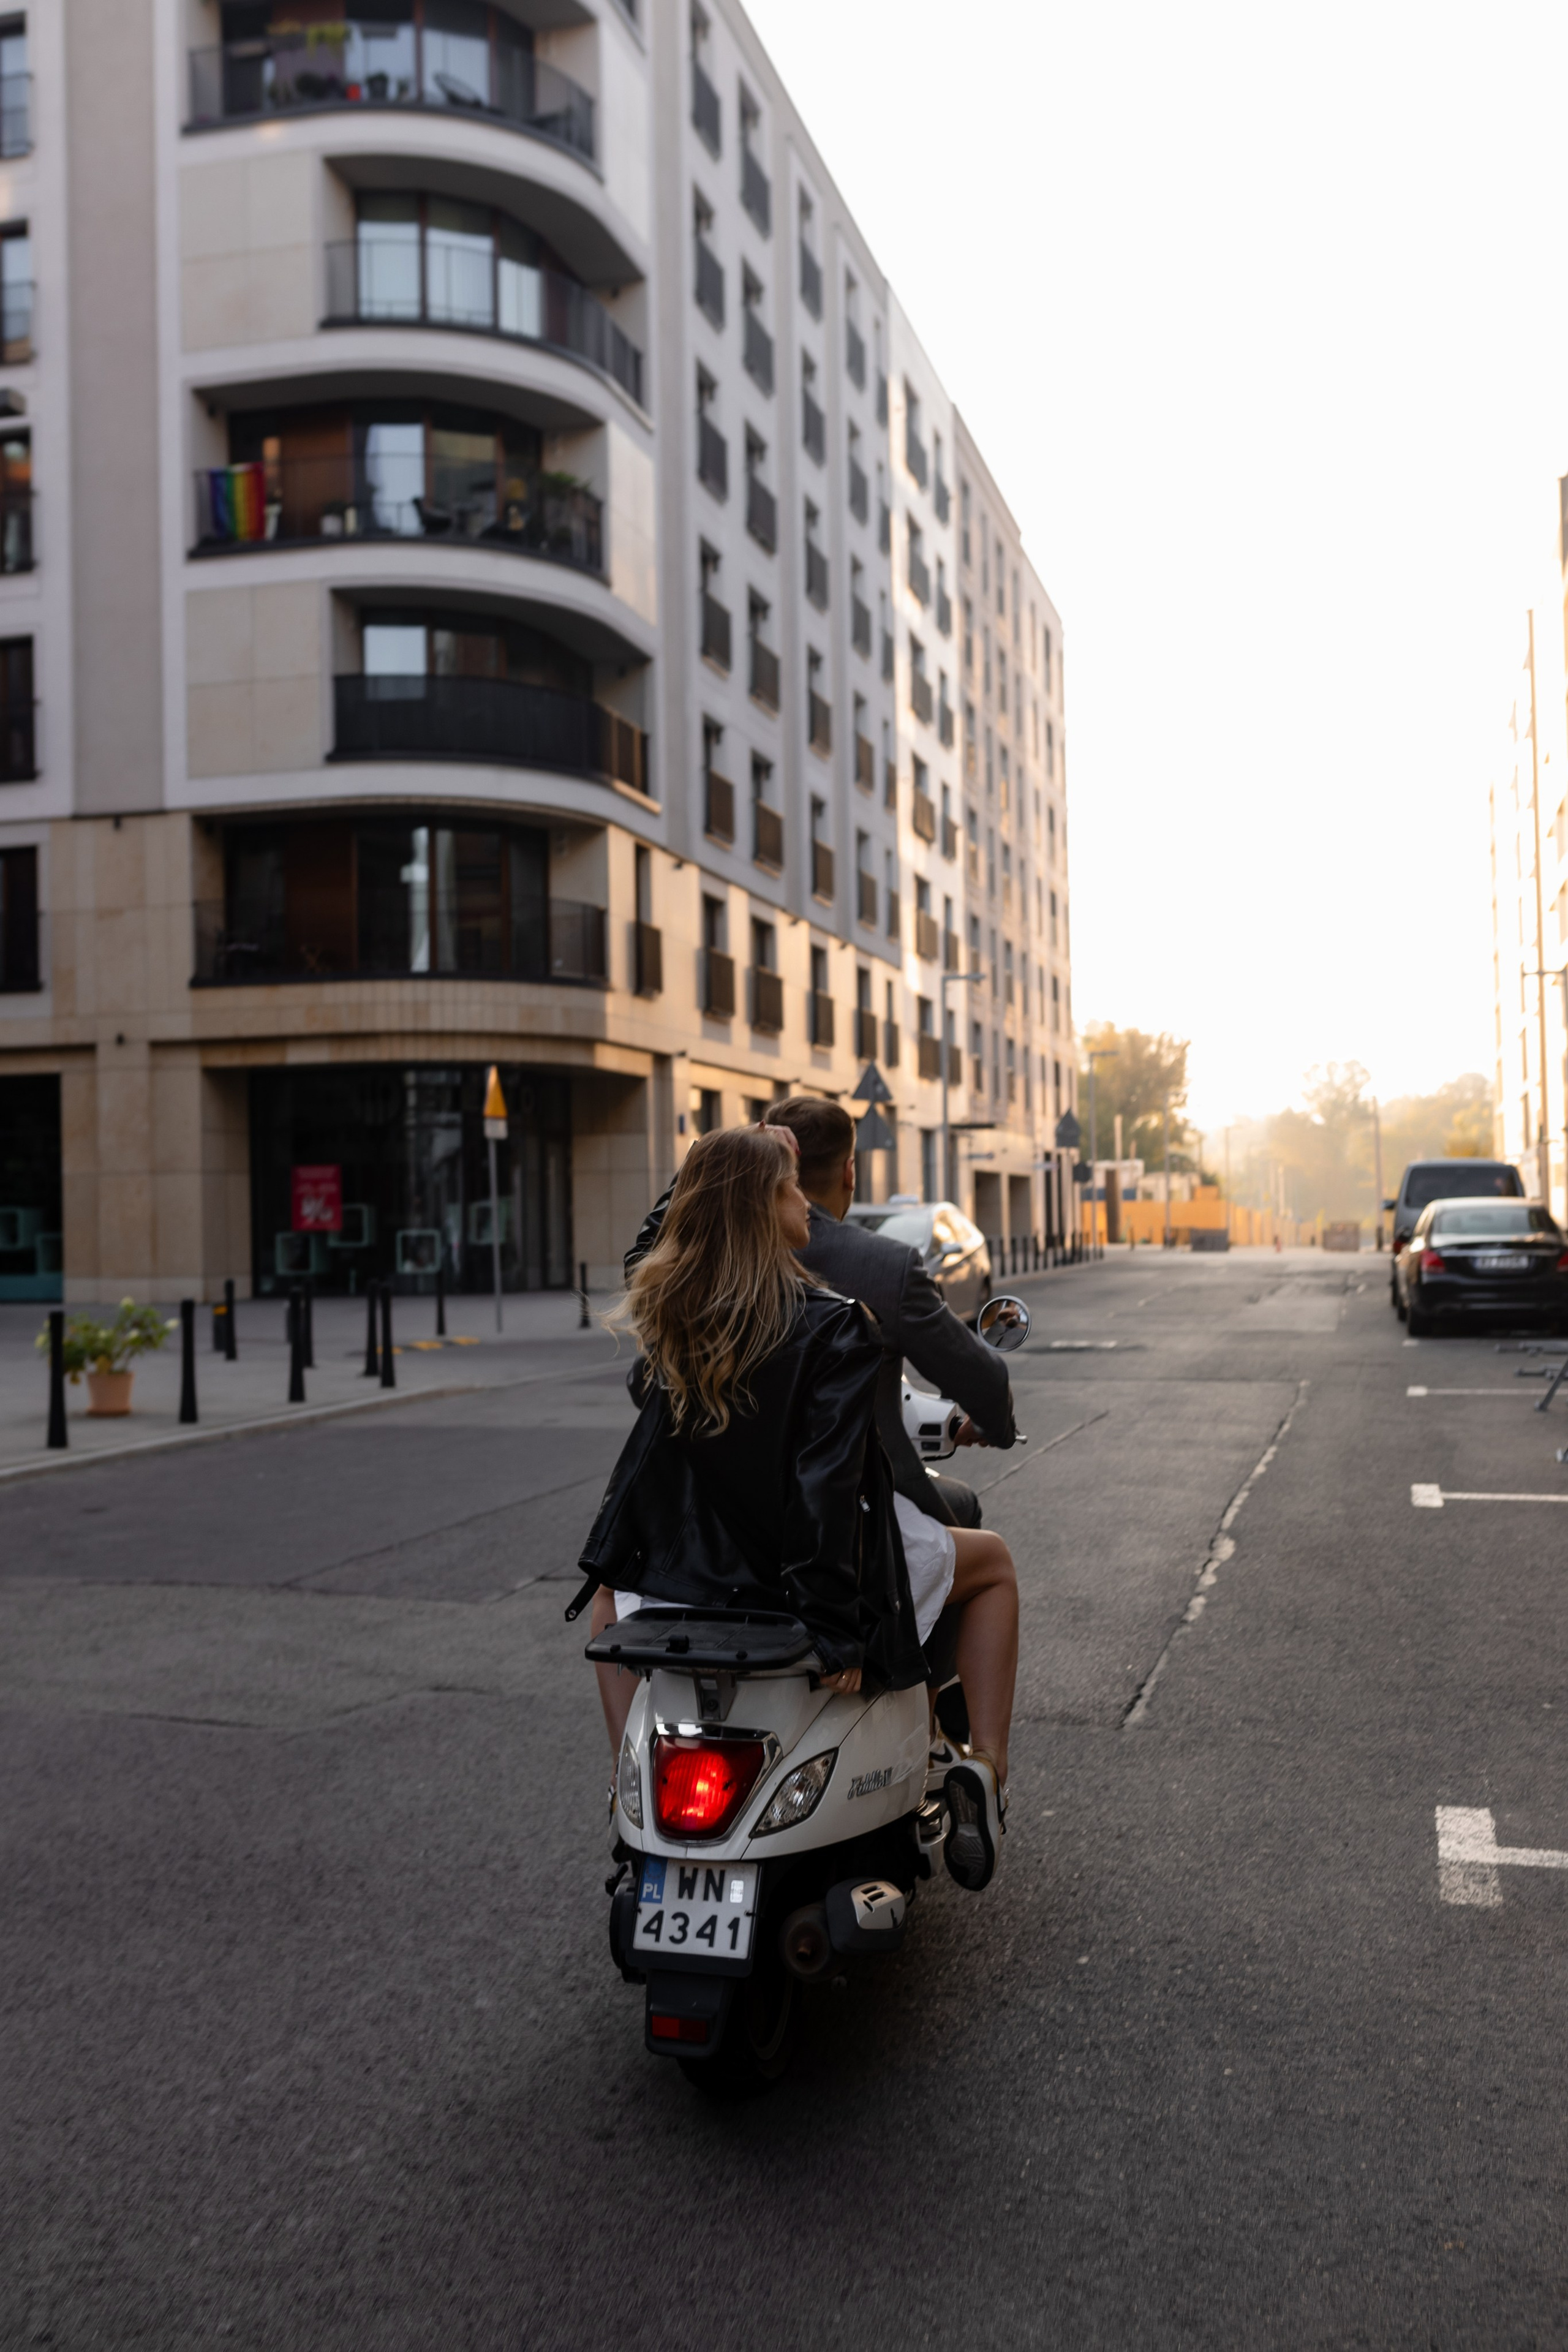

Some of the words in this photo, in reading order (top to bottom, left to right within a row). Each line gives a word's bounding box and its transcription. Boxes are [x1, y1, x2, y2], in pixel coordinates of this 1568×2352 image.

[643, 1882, 661, 1899] PL
[678, 1866, 726, 1902] WN
[642, 1909, 741, 1951] 4341
